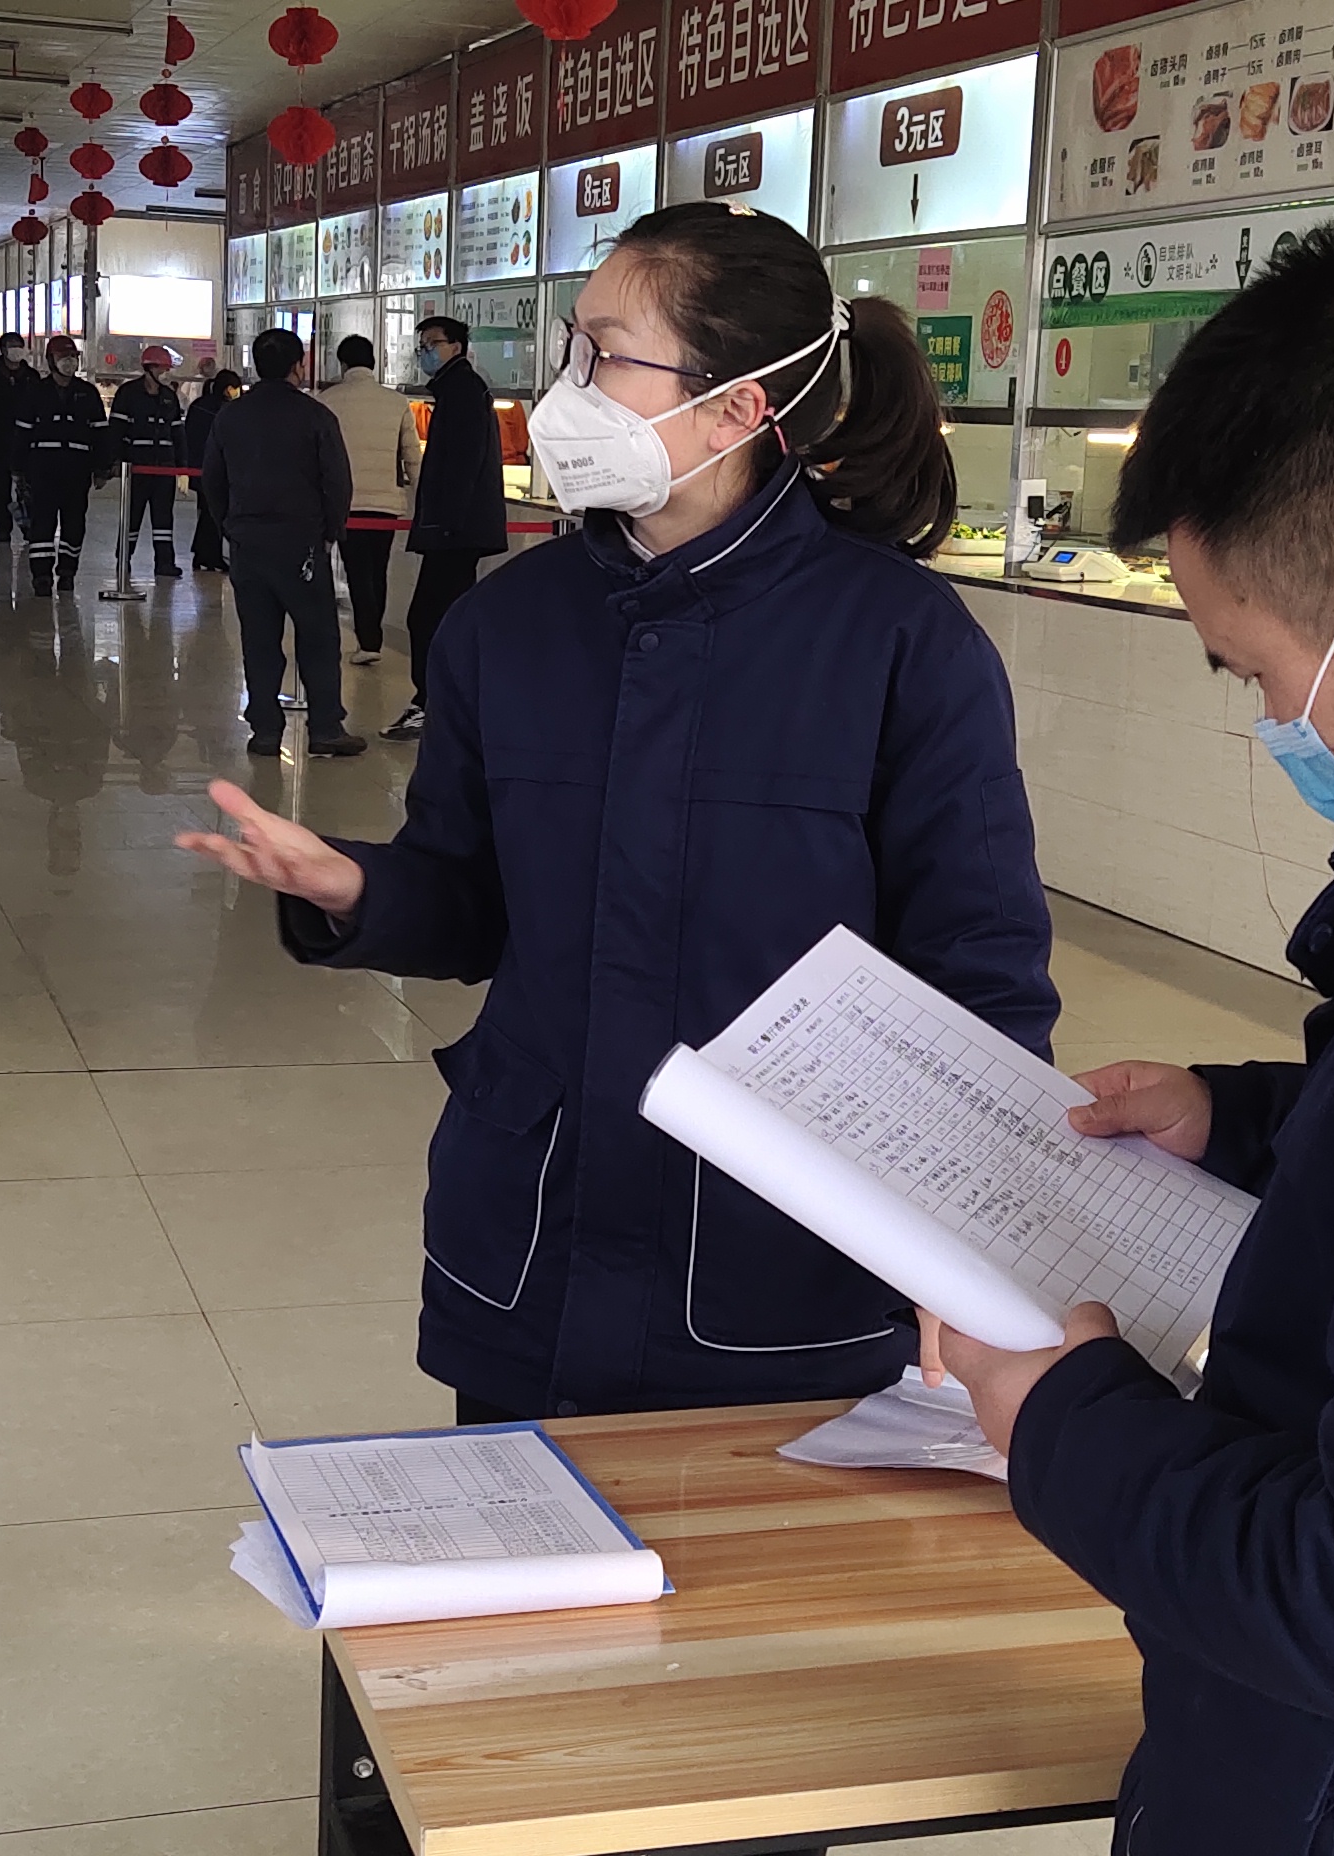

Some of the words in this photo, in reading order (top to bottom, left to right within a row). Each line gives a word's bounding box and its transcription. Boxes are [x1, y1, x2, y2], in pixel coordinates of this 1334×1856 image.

[1249, 33, 1266, 50] 15元
[557, 27, 657, 134] 特色自选区
[1247, 60, 1264, 76] 15元
[469, 73, 534, 153] 盖浇饭
[894, 106, 946, 153] 3元区
[389, 104, 448, 174] 干锅汤锅
[714, 147, 751, 188] 5元区
[583, 173, 612, 208] 8元区
[1051, 260, 1108, 298] 点餐区
